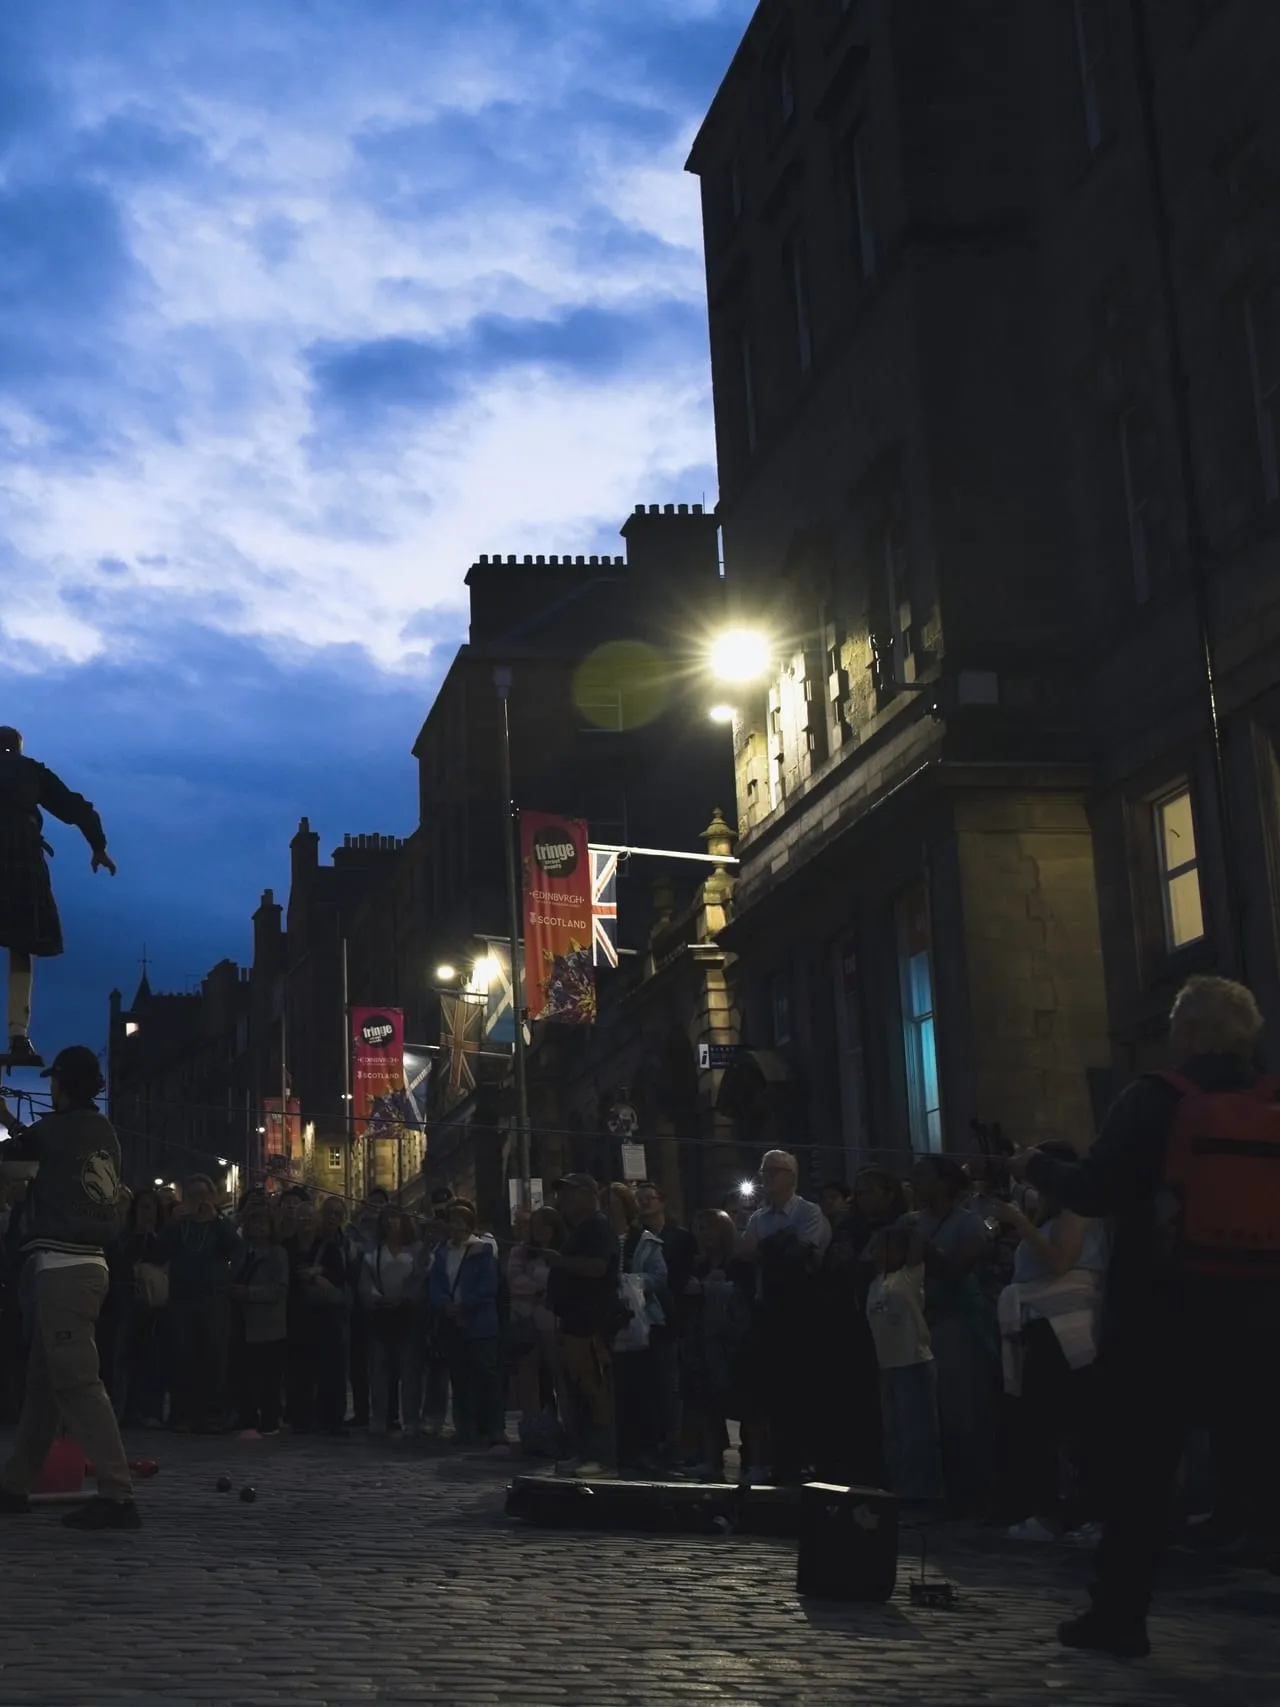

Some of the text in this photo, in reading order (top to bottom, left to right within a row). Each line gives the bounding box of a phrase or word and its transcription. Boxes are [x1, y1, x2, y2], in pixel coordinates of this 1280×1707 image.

[535, 843, 575, 861] fringe
[538, 915, 586, 929] SCOTLAND
[362, 1024, 392, 1038] fringe
